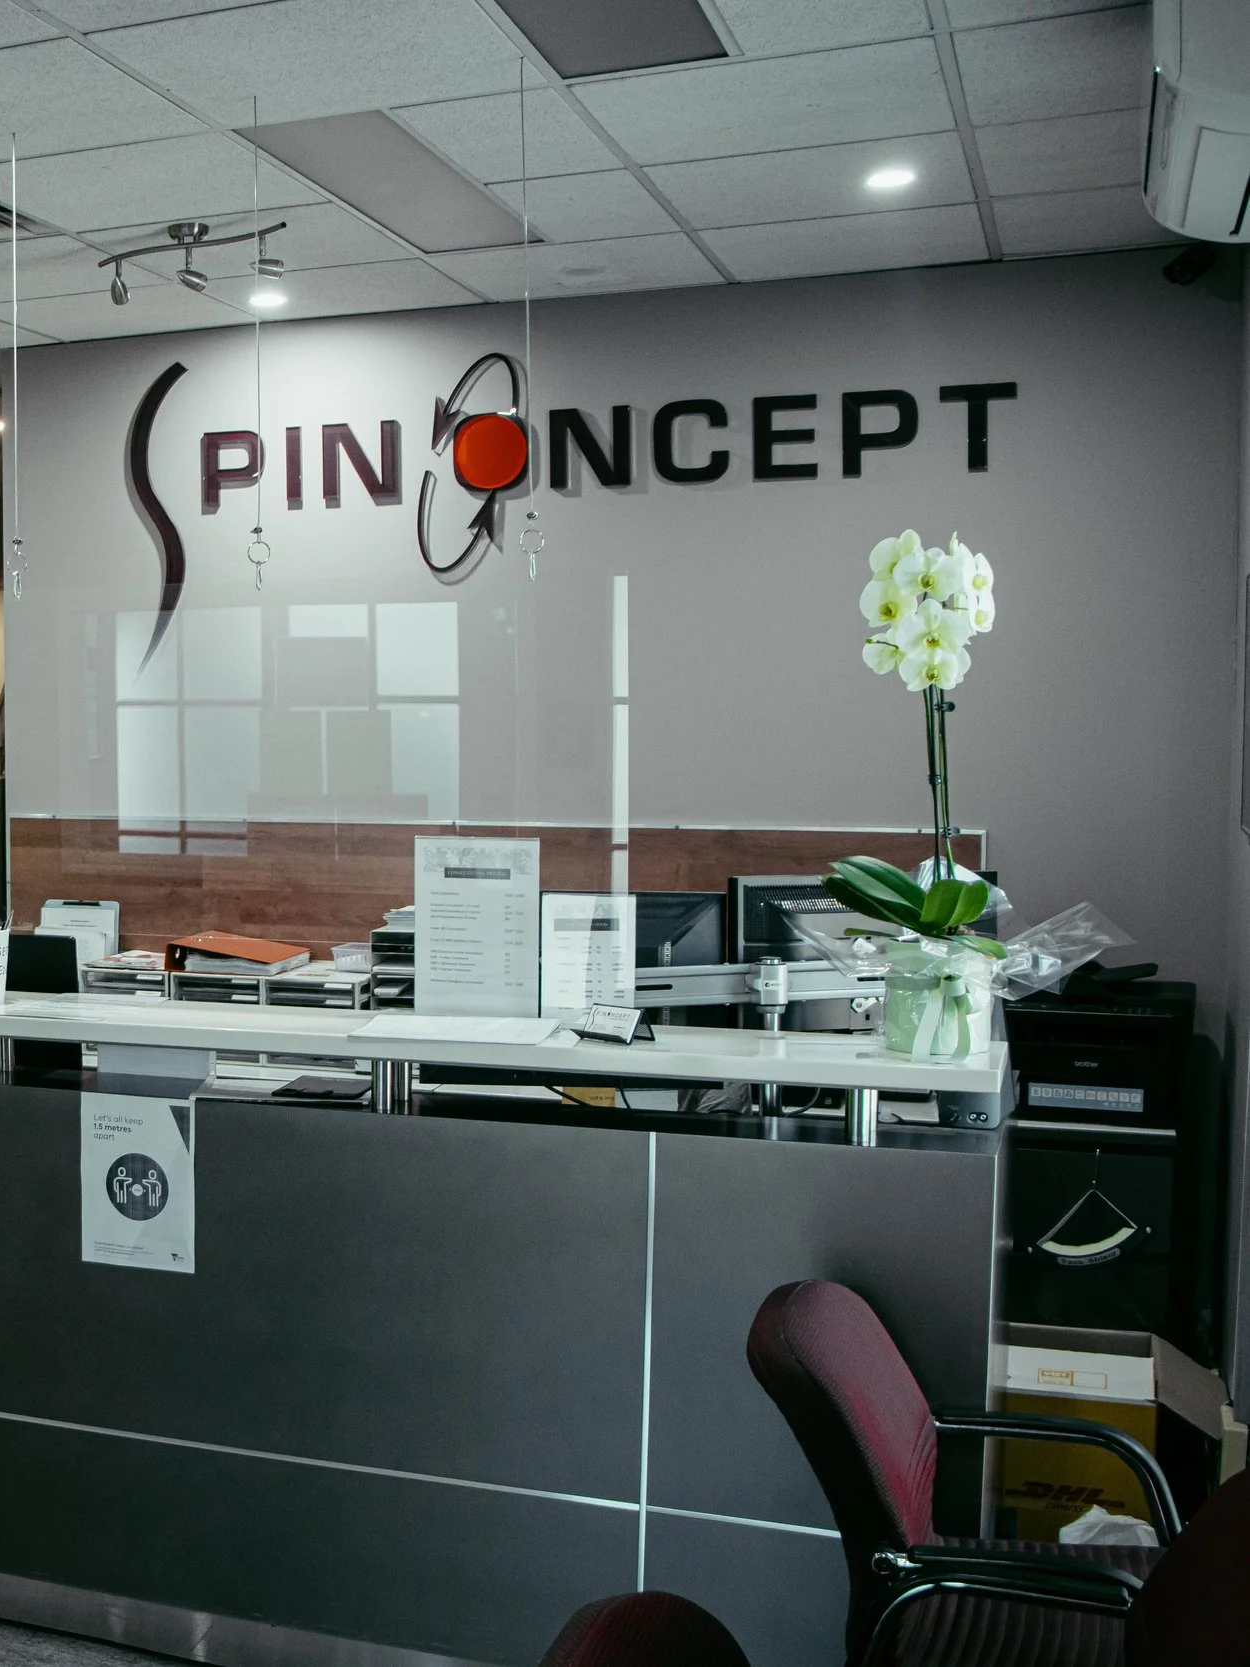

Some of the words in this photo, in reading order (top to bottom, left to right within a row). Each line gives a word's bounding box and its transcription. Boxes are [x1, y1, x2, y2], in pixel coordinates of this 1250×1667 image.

[1074, 1060, 1099, 1068] brother
[93, 1113, 112, 1123] Let's
[113, 1115, 123, 1123] all
[124, 1116, 144, 1126] keep
[93, 1122, 103, 1130] 1.5
[104, 1125, 132, 1133] metres
[93, 1132, 115, 1141] apart
[1088, 1250, 1117, 1264] Shield
[1022, 1481, 1106, 1505] DHL
